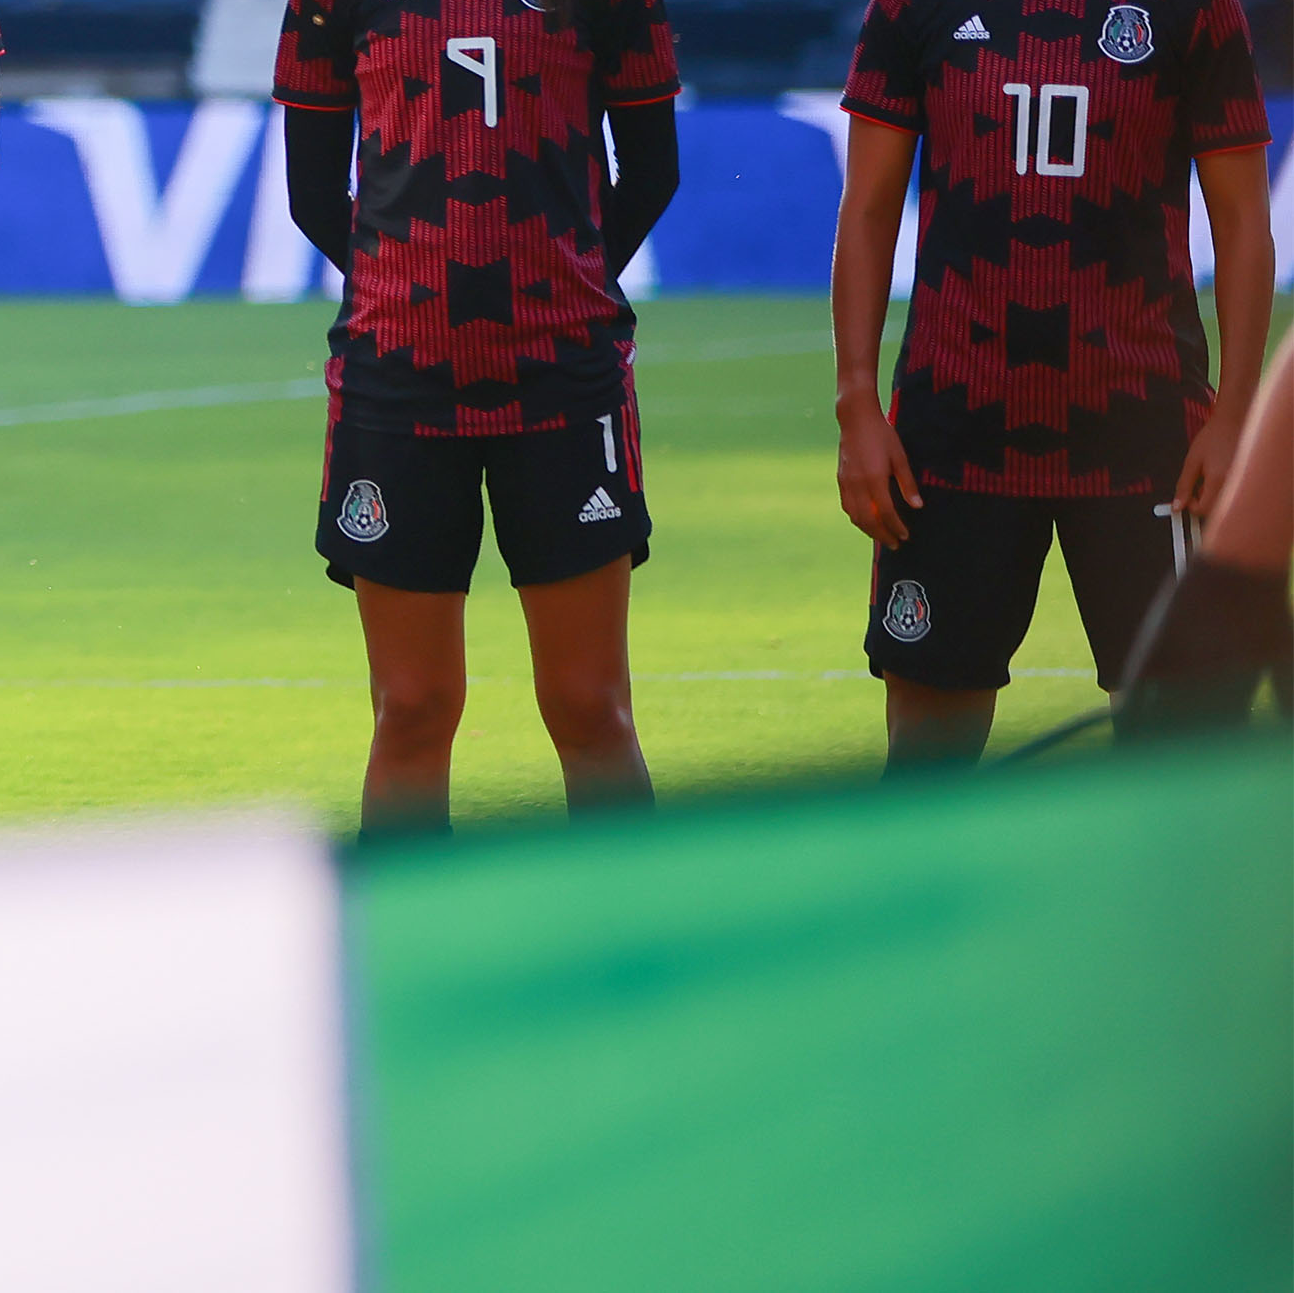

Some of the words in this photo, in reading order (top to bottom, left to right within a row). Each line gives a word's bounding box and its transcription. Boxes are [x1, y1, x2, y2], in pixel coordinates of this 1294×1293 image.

[952, 29, 991, 41] adidas
[446, 36, 498, 128] 9
[1002, 82, 1090, 178] 10
[578, 506, 622, 523] adidas
